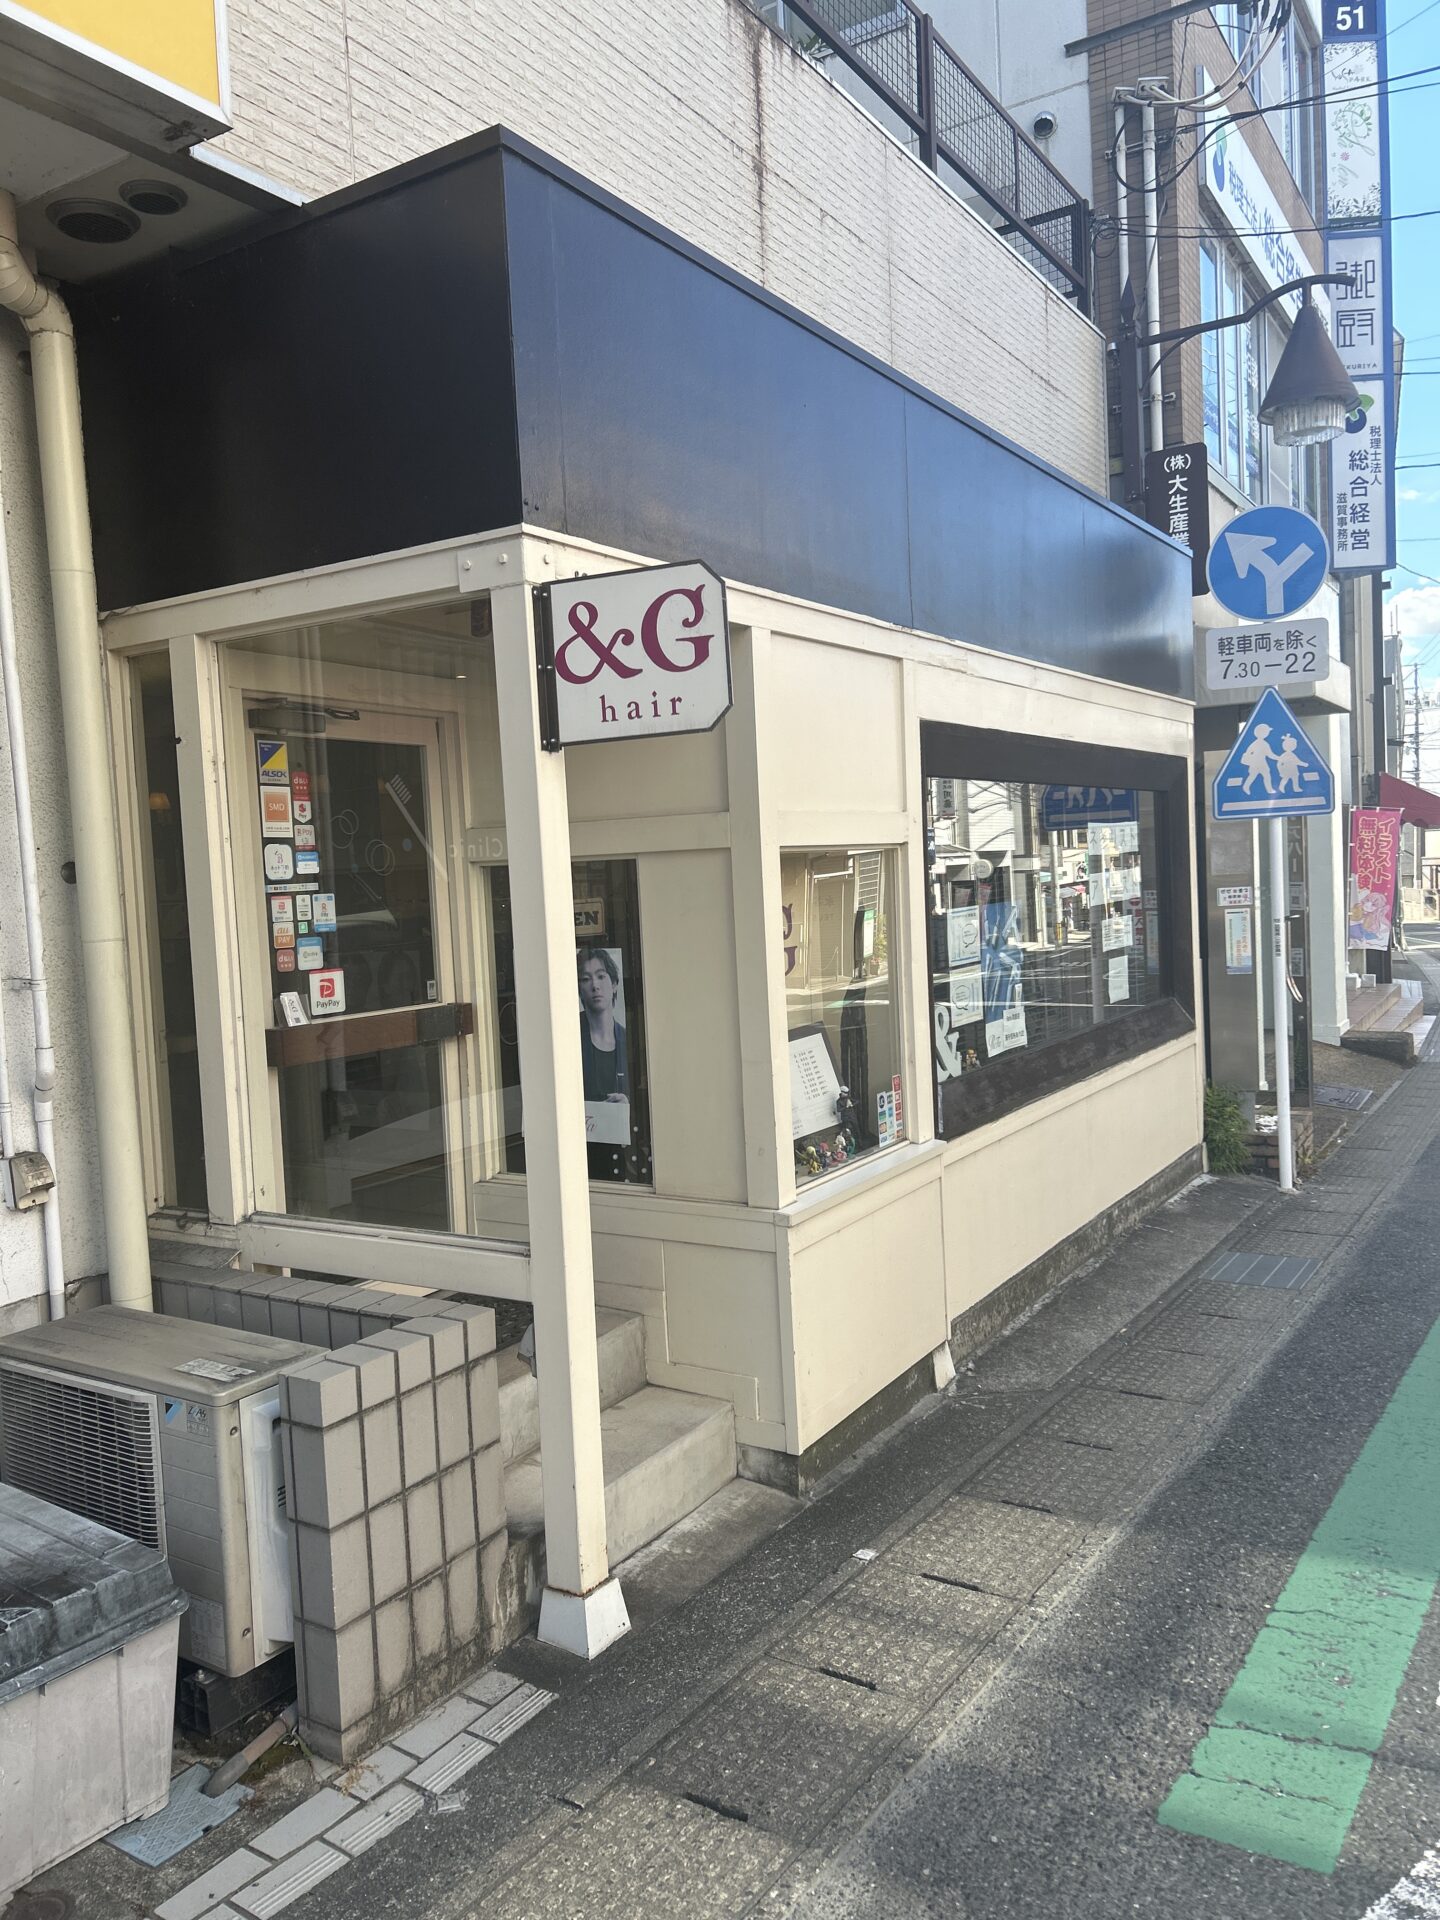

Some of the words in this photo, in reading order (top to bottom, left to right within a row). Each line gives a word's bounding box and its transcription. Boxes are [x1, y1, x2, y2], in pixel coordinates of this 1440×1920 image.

[1336, 5, 1365, 31] 51
[1369, 425, 1382, 486] 税理士法人
[1348, 449, 1371, 551] 総合経営
[1336, 492, 1348, 552] 滋賀事務所
[554, 583, 715, 685] &G
[1217, 629, 1318, 657] 軽車両を除く
[599, 690, 682, 723] hair
[261, 770, 287, 778] ALSOK
[1375, 817, 1395, 884] イラスト
[278, 935, 291, 943] PAY
[316, 1000, 340, 1009] PayPay
